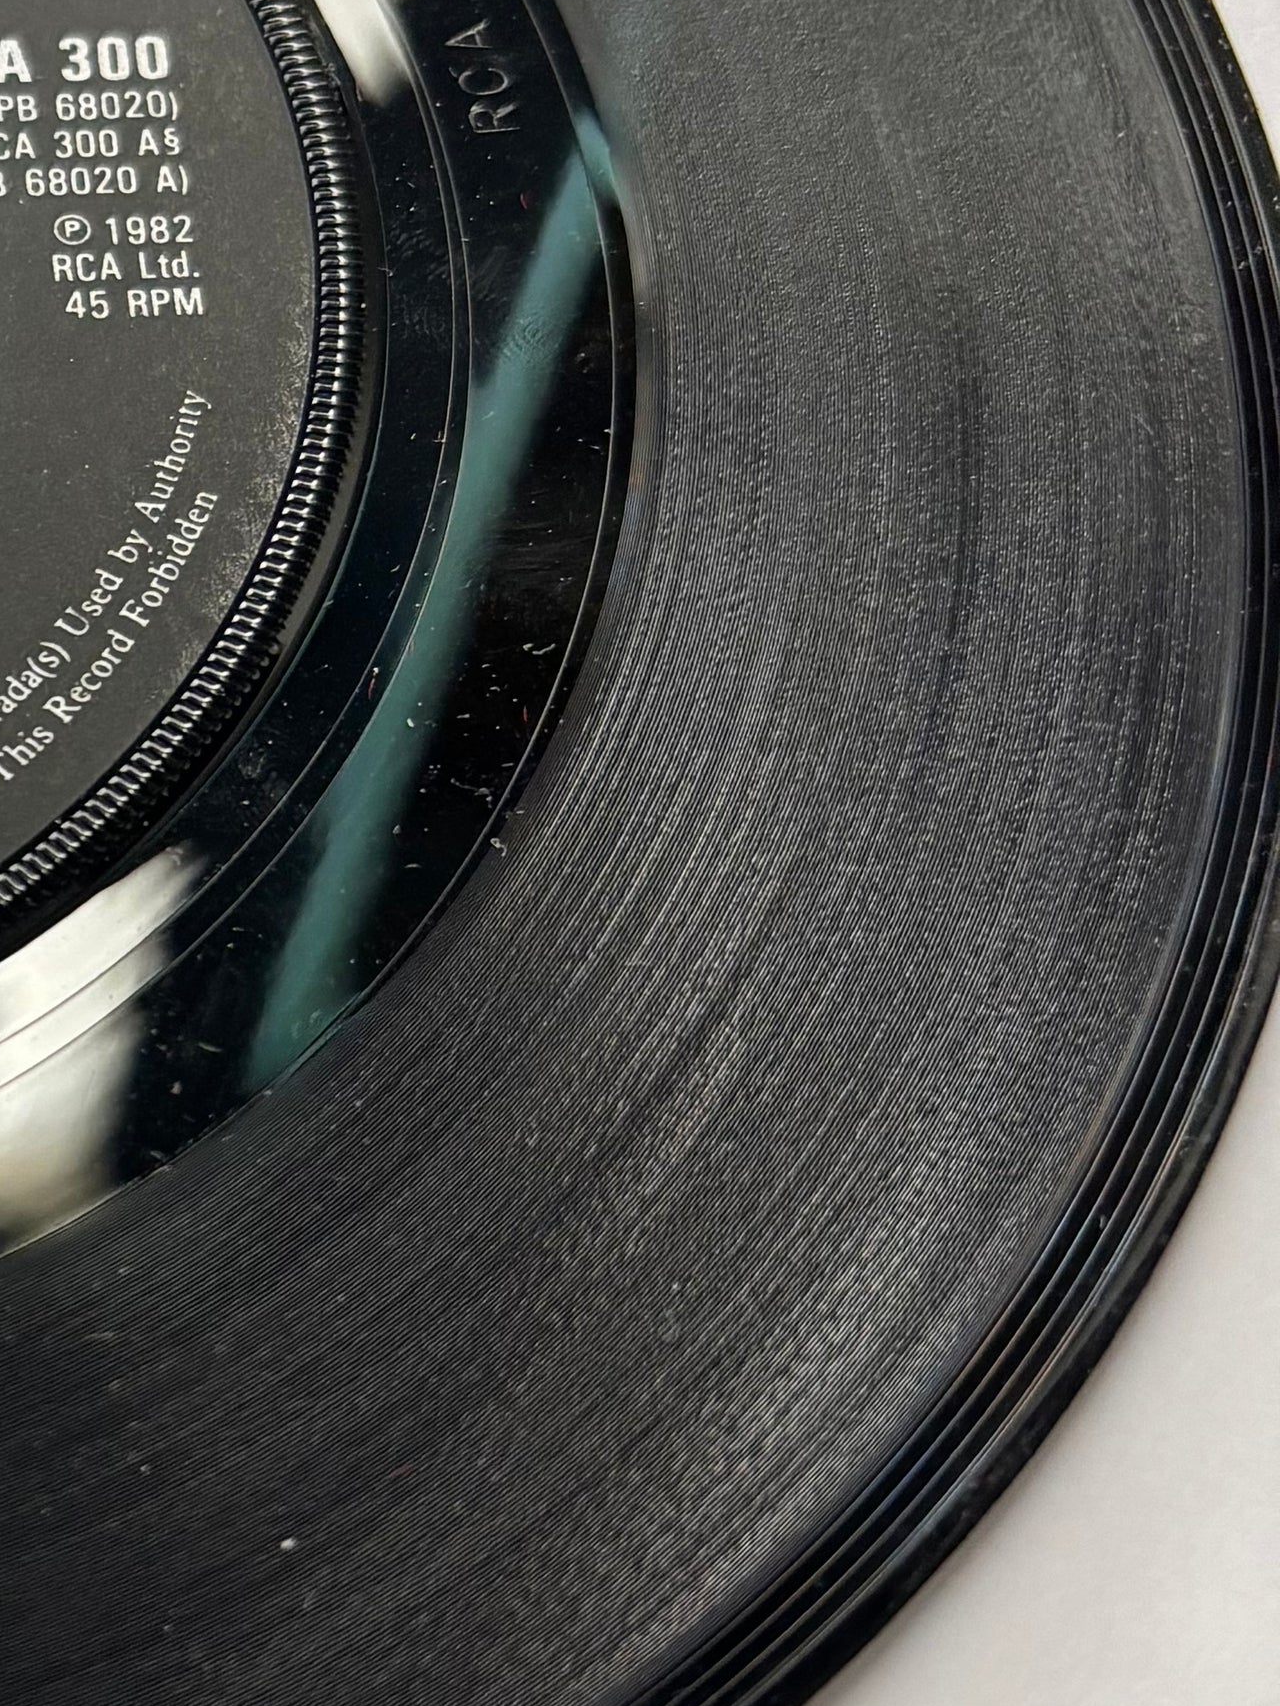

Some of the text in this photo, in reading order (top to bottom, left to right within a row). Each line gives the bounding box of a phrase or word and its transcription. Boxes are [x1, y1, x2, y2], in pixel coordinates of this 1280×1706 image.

[58, 35, 169, 81] 300
[444, 18, 520, 134] RCA
[55, 91, 179, 122] 68020)
[52, 130, 119, 159] 300
[24, 167, 138, 197] 68020
[156, 164, 189, 195] A)
[104, 216, 194, 245] 1982
[52, 250, 201, 282] RCA Ltd.
[64, 287, 204, 318] 45 RPM
[53, 568, 124, 637] Used
[107, 529, 155, 564] by
[133, 390, 212, 523] Authority
[42, 627, 137, 724] Record
[119, 490, 220, 629] Forbidden
